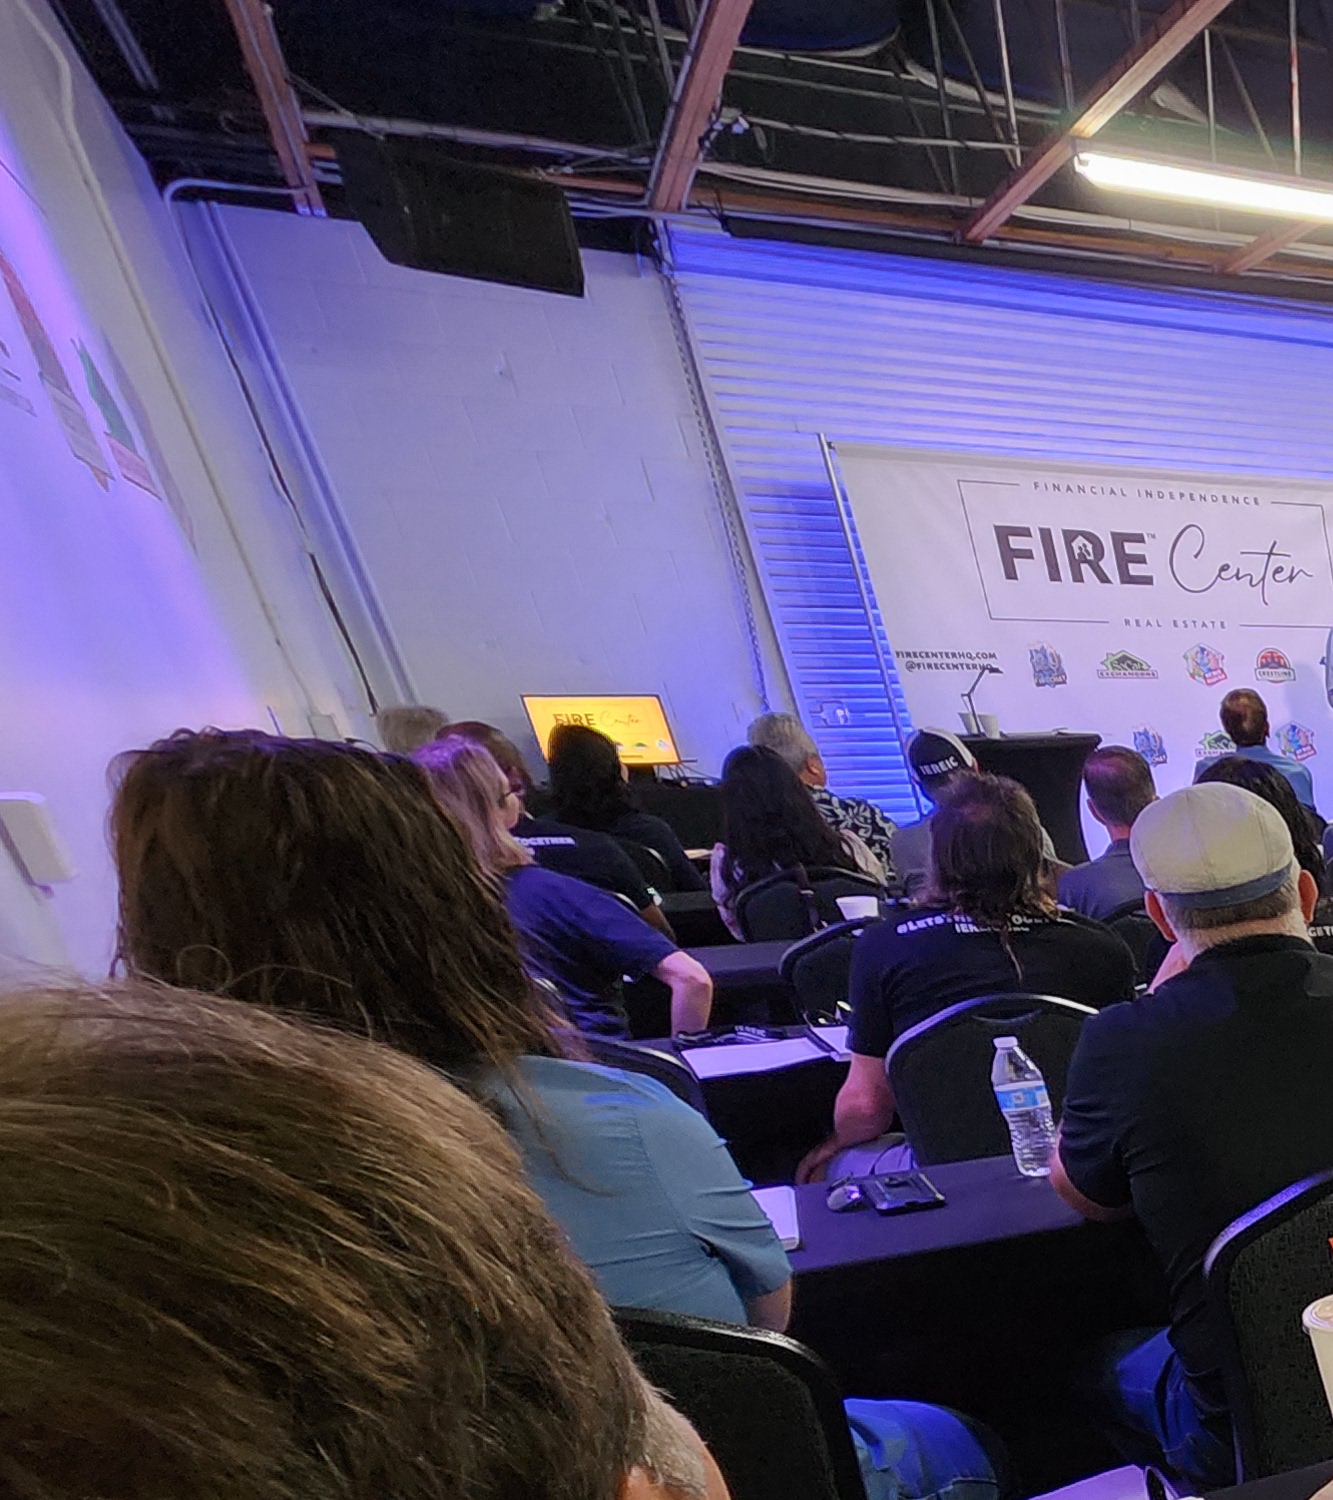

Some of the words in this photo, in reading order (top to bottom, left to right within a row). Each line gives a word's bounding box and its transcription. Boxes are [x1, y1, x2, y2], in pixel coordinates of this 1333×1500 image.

[1032, 481, 1128, 497] FINANCIAL
[1137, 488, 1260, 506] INDEPENDENCE
[1169, 523, 1314, 606] Center
[1124, 618, 1163, 628] REAL
[1172, 619, 1227, 630] ESTATE
[895, 650, 998, 662] FIRECENTERHQ.COM
[920, 755, 959, 776] IEREIC
[513, 836, 576, 847] OGETHER
